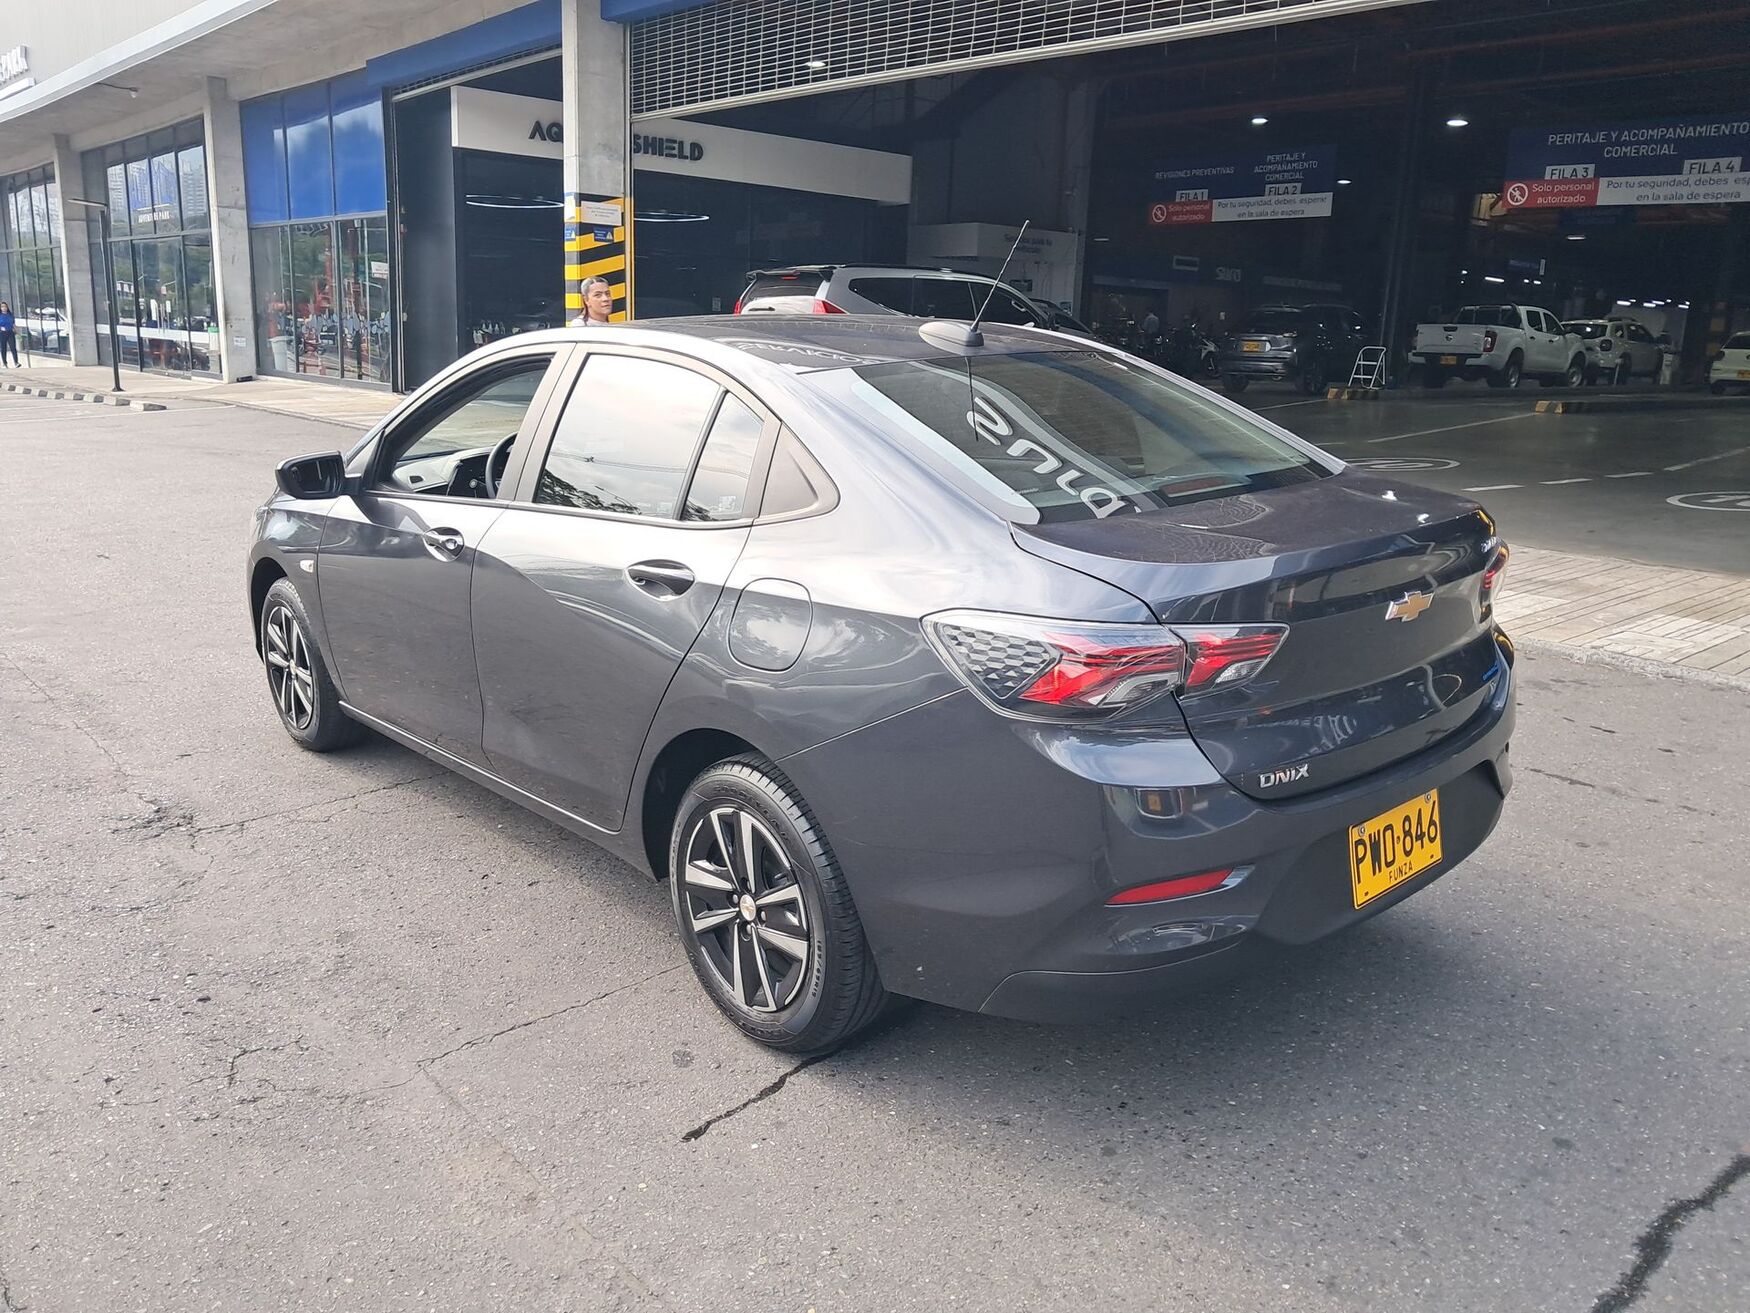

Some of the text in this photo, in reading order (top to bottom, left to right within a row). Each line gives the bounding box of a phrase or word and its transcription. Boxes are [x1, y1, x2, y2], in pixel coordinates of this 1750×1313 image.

[1548, 121, 1750, 146] PERITAJE Y ACOMPAÑAMIENTO
[1603, 143, 1678, 159] COMERCIAL
[1266, 153, 1299, 163] PERITAJE
[1191, 166, 1235, 177] PREVENTIVAS
[1550, 166, 1589, 180] FILA 3
[1688, 160, 1735, 175] FILA 4
[1265, 171, 1305, 182] COMERCIAL
[1606, 179, 1622, 189] Por
[1625, 180, 1636, 189] tu
[1694, 176, 1728, 186] debes
[1267, 185, 1298, 196] FILA 2
[1531, 181, 1595, 194] Solo personal
[1180, 191, 1199, 201] FILA
[1536, 194, 1586, 204] autorizado
[1636, 190, 1741, 203] en la sala de espera
[1388, 859, 1414, 884] FUNZA
